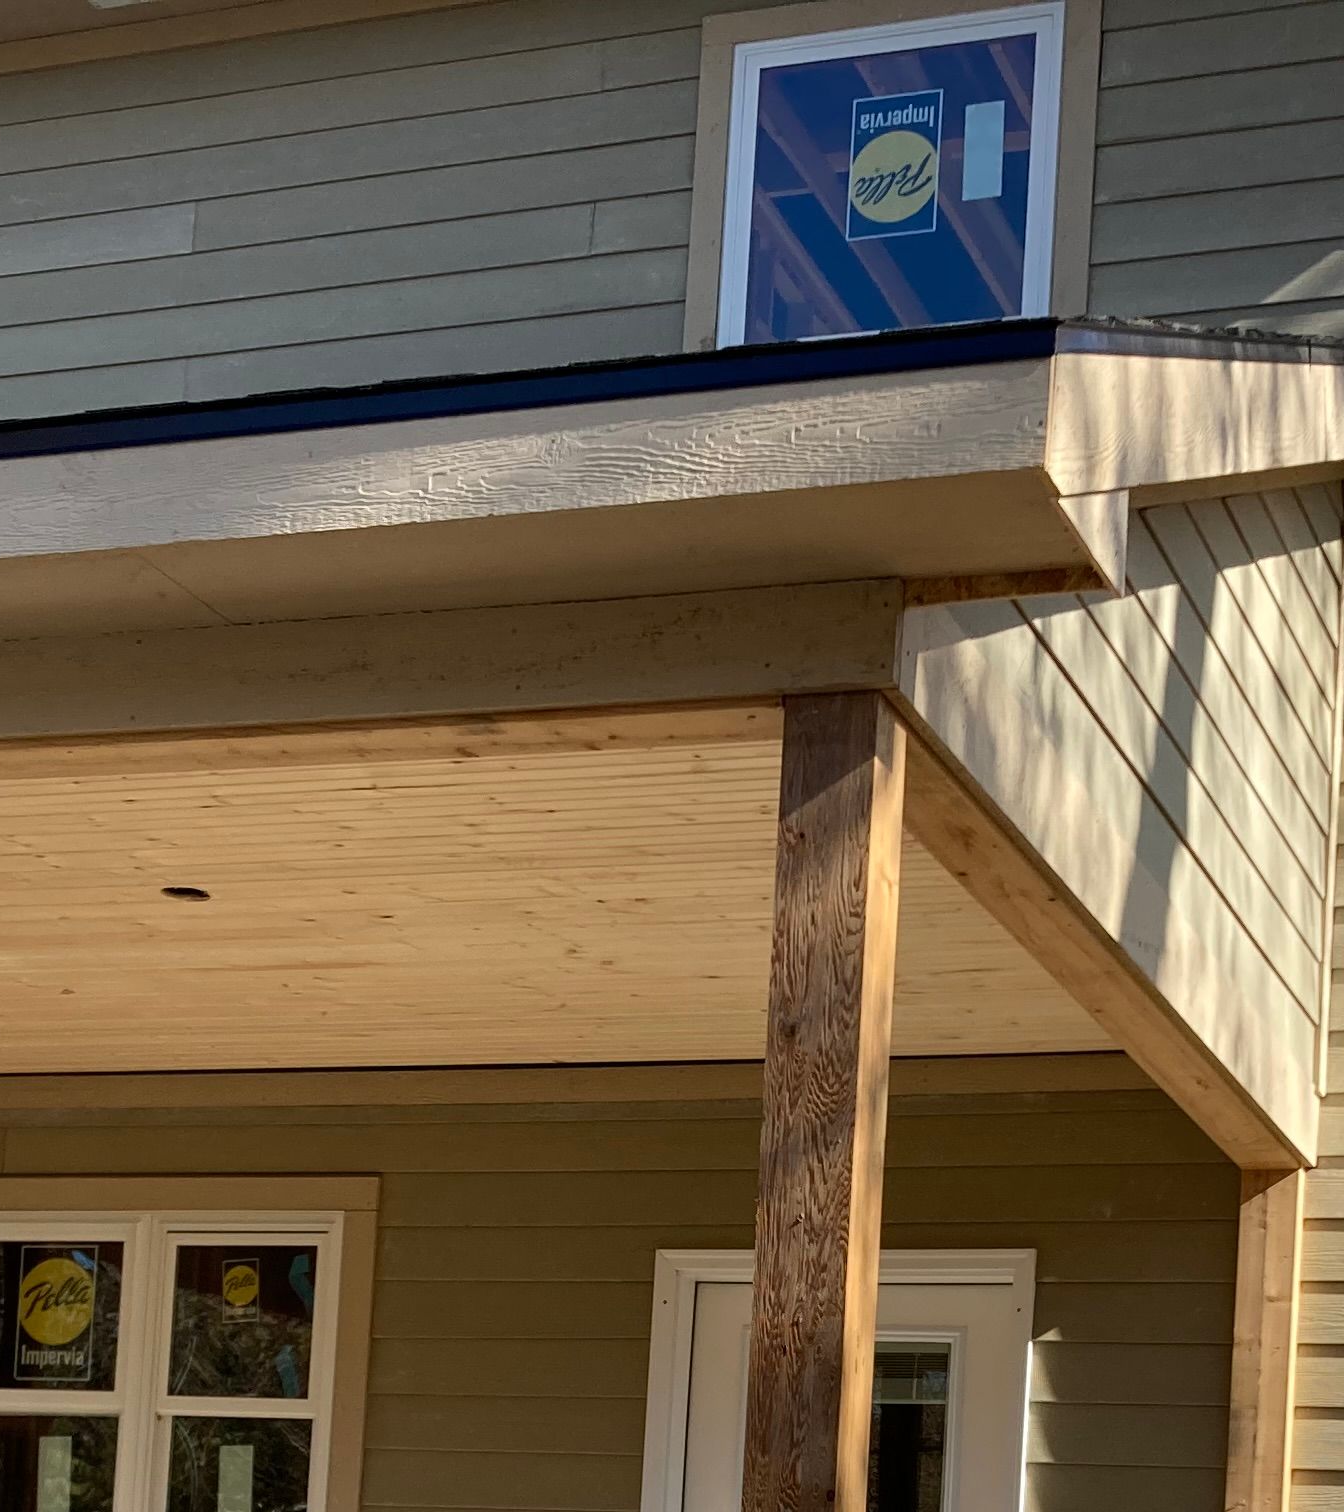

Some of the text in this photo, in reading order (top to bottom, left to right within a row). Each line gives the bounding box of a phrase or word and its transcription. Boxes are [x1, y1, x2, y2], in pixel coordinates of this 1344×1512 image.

[860, 104, 934, 133] Impervia
[855, 153, 933, 206] Pella
[24, 1276, 91, 1319] Pella
[21, 1344, 85, 1369] Impervia
